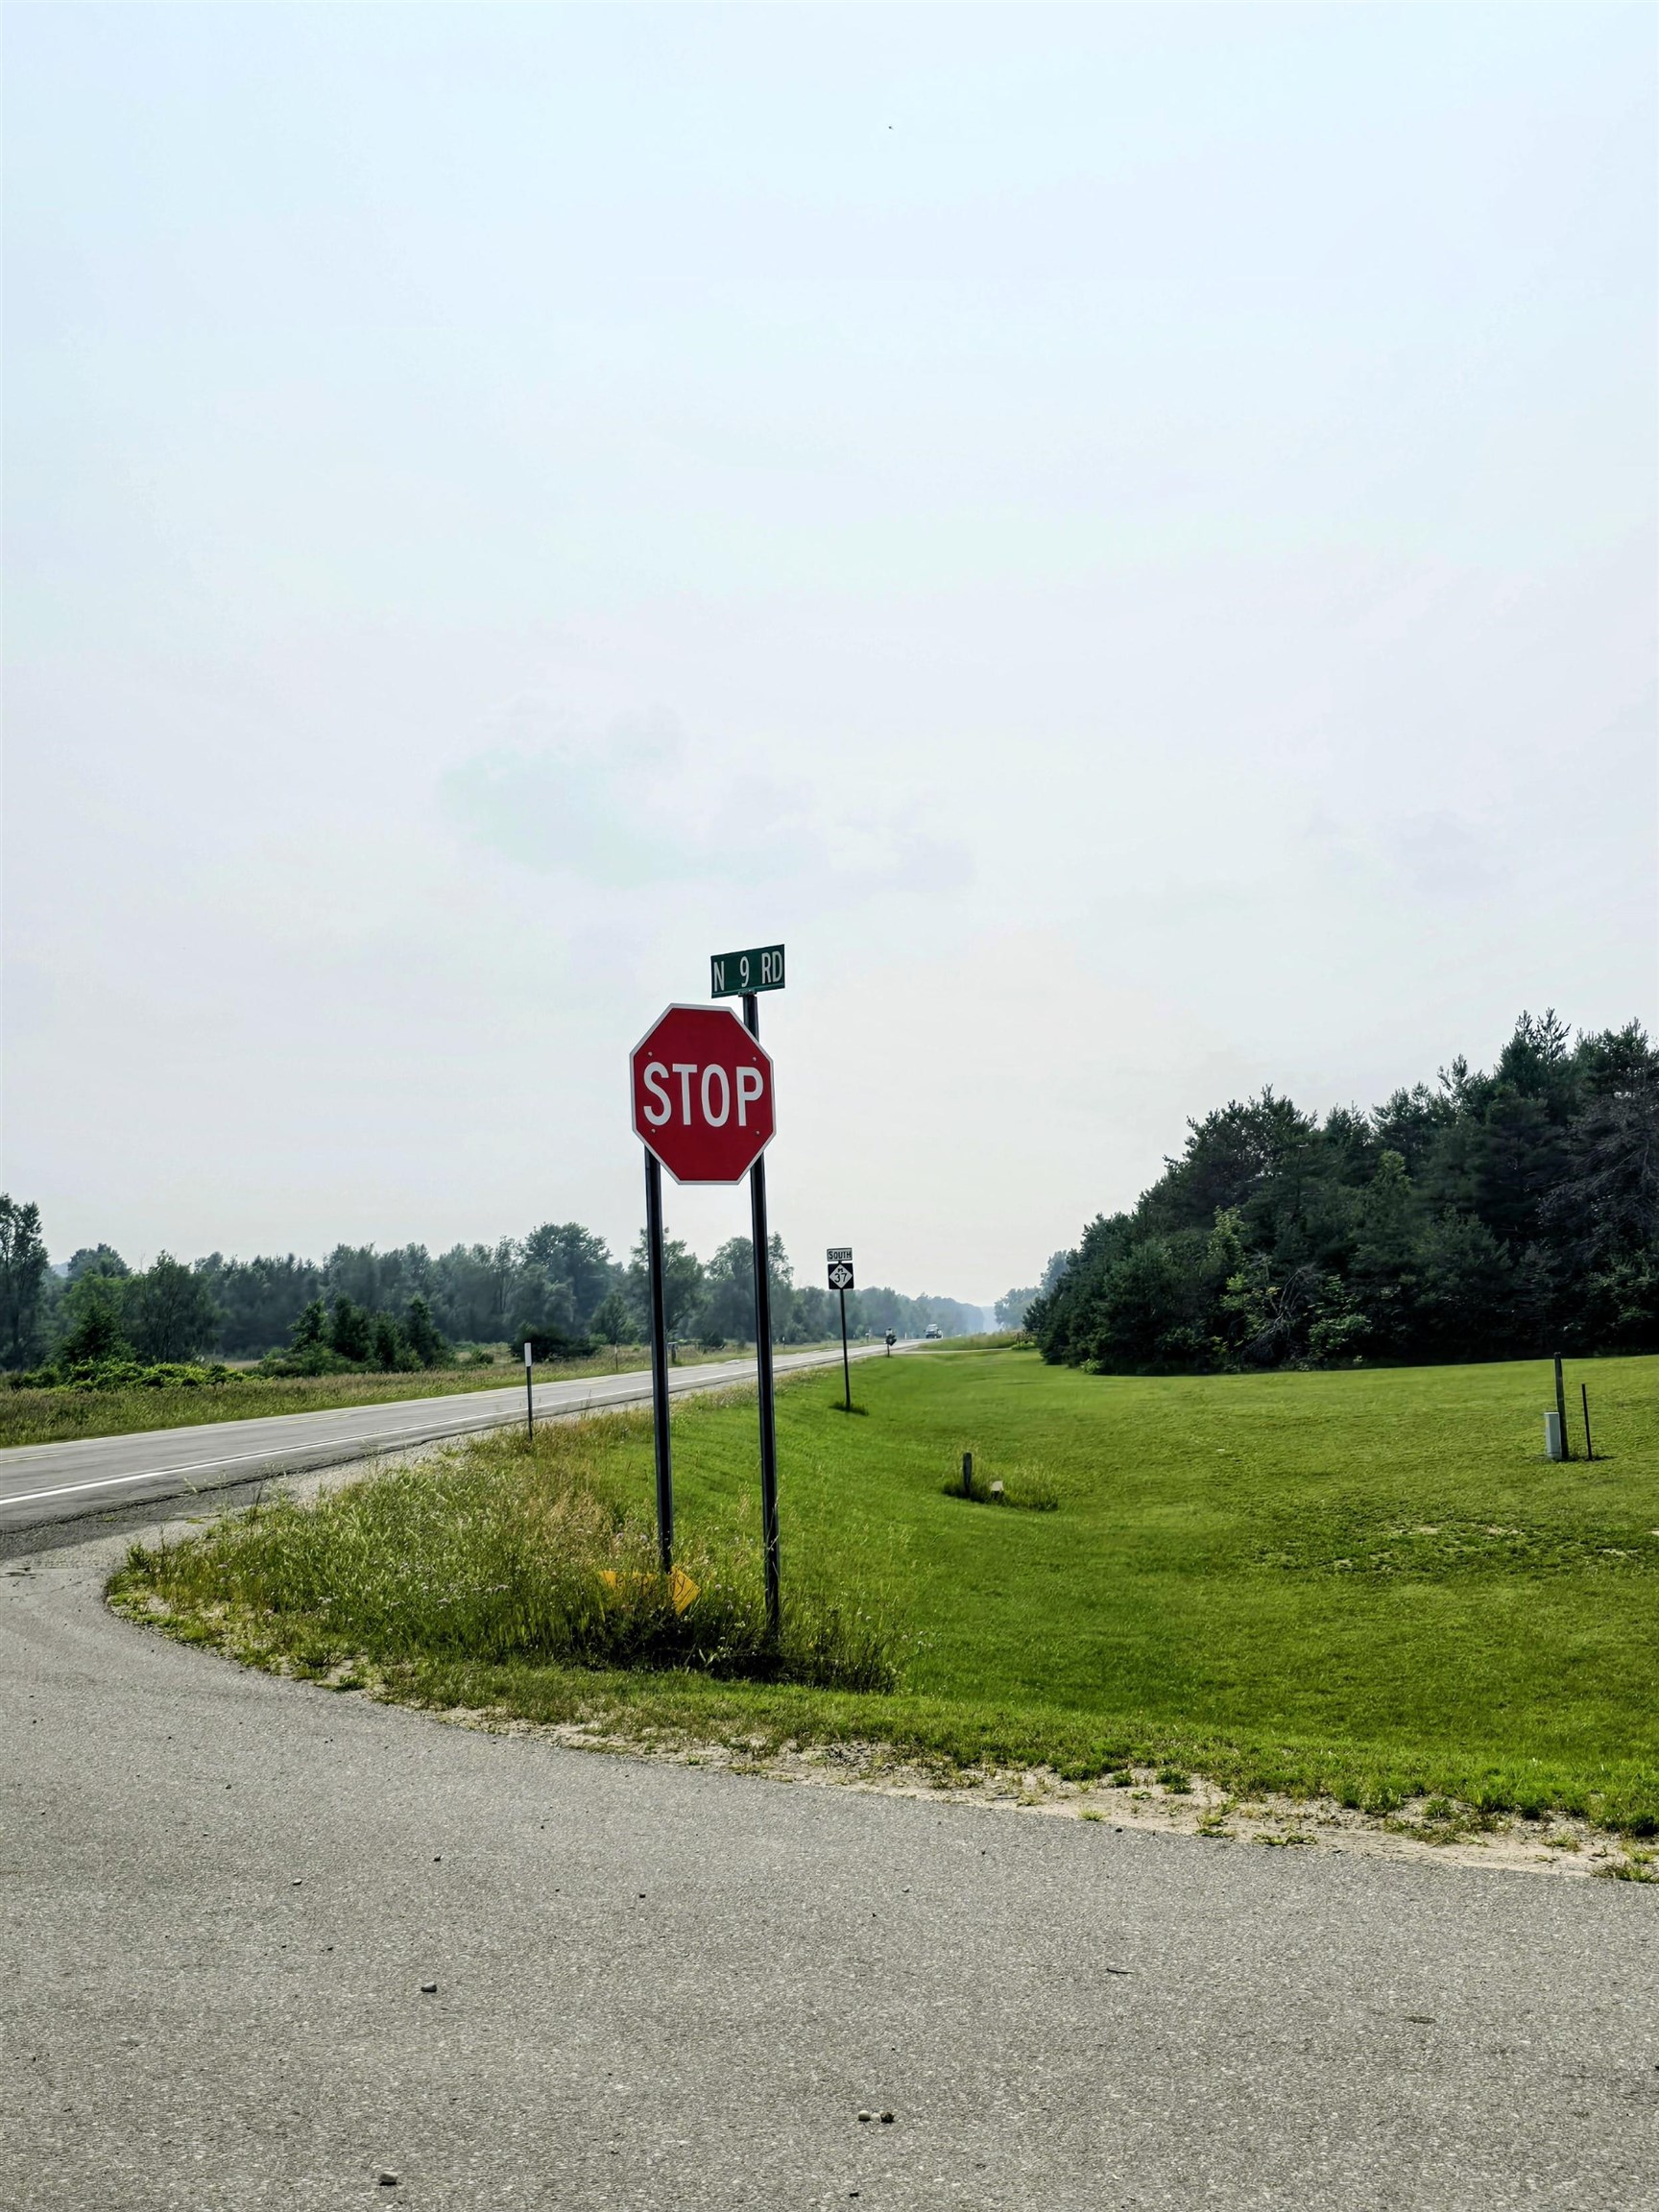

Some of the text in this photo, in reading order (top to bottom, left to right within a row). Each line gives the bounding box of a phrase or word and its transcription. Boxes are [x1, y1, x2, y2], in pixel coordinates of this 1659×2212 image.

[713, 950, 782, 992] N 9 RD
[643, 1061, 764, 1127] STOP
[828, 1250, 852, 1259] SOUTH
[834, 1273, 848, 1283] 37
